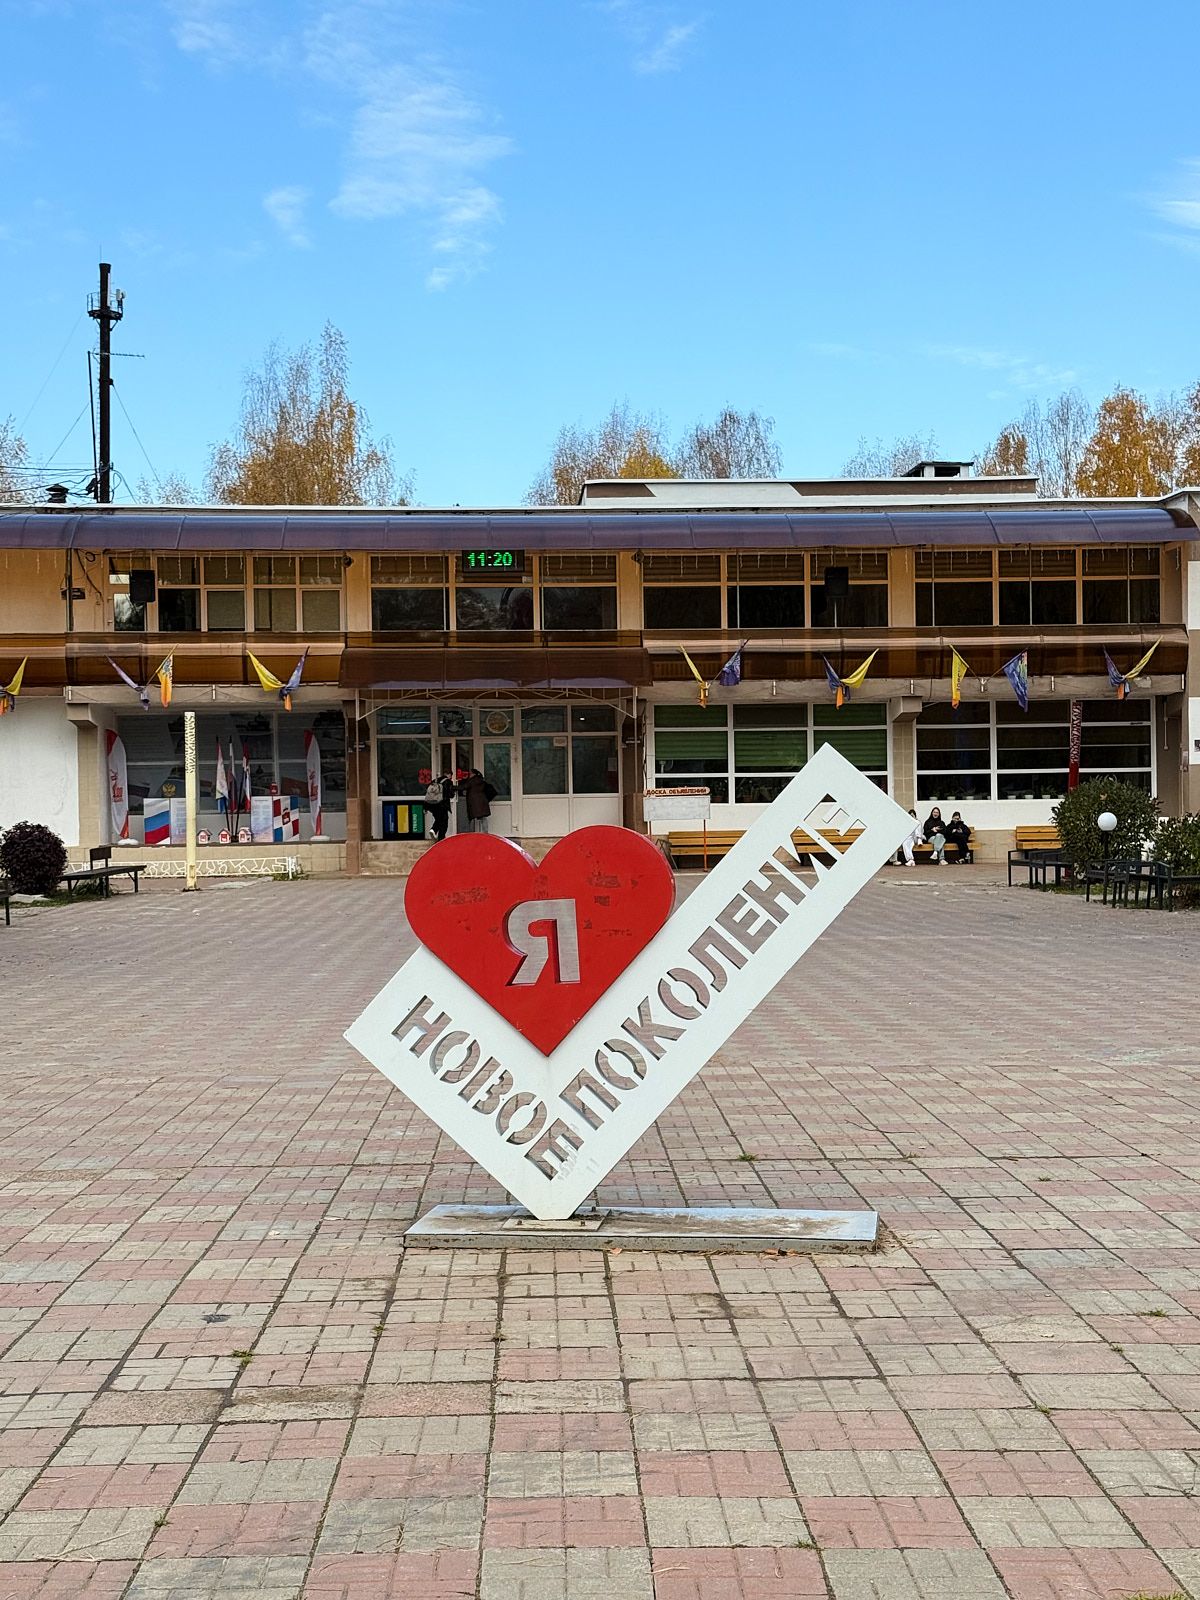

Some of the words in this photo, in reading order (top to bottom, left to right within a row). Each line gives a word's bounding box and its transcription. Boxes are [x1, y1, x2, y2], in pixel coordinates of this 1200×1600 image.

[467, 552, 513, 567] 11:20
[505, 898, 582, 987] Я
[558, 793, 868, 1131] ПОКОЛЕНИЕ
[391, 995, 585, 1181] НОВОЕ
